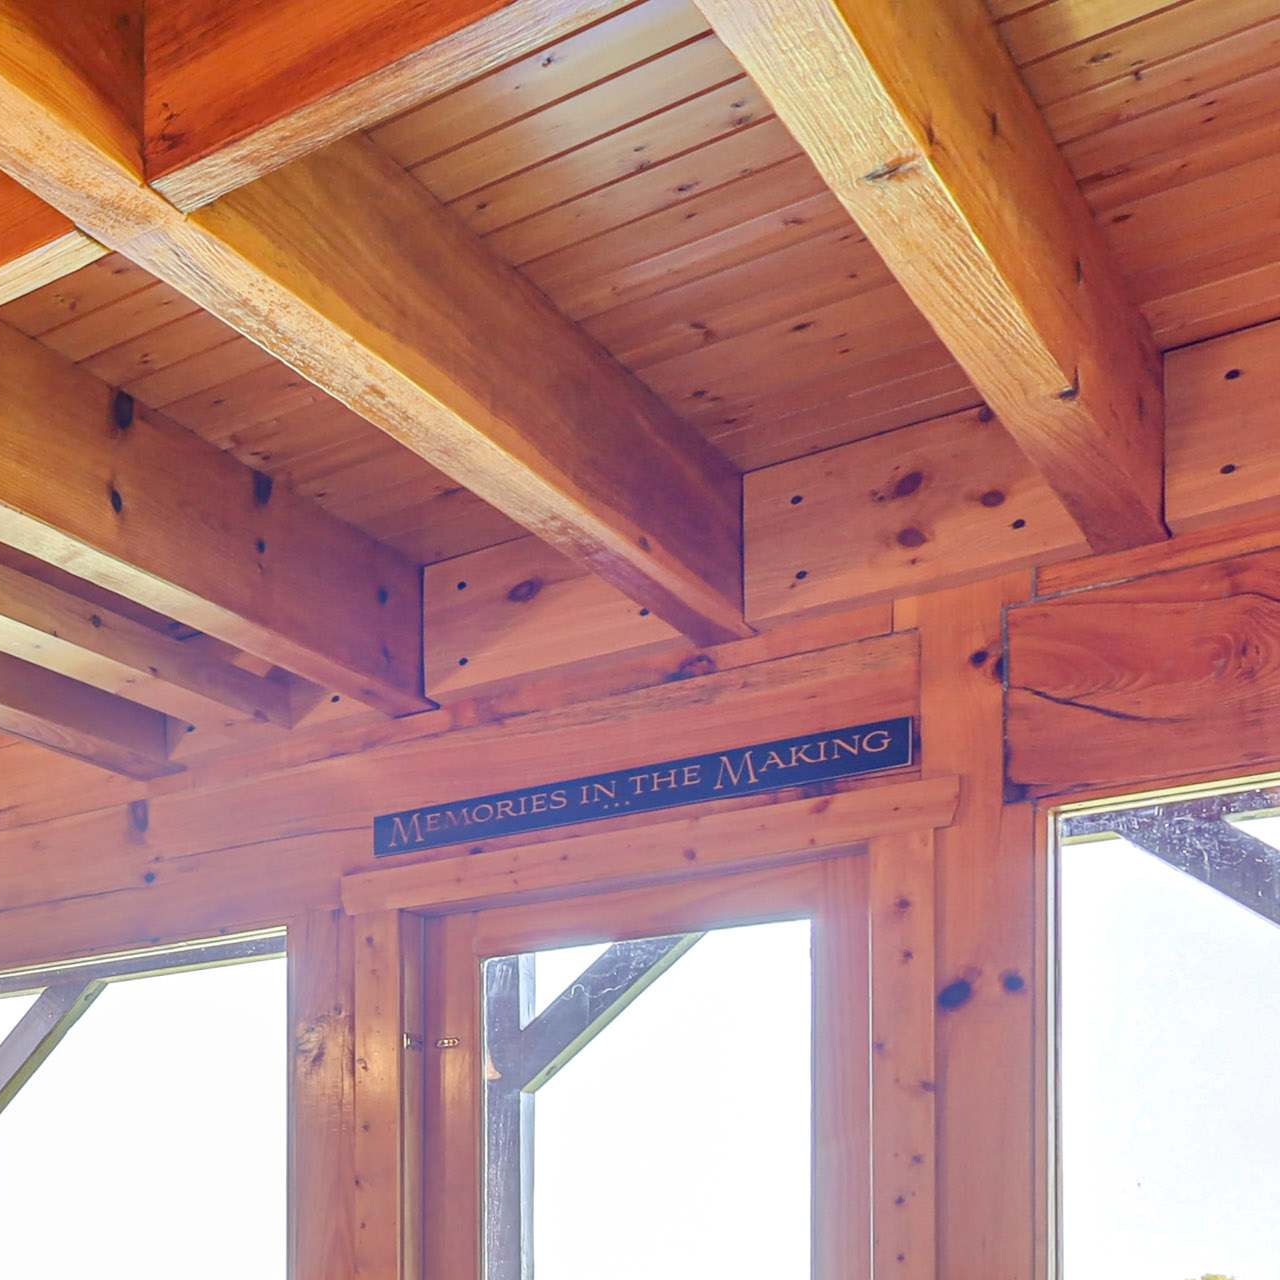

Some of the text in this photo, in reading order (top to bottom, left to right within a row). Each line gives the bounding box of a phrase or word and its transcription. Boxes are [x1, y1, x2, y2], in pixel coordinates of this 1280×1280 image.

[388, 730, 892, 848] MEMORIES IN THE MAKING
